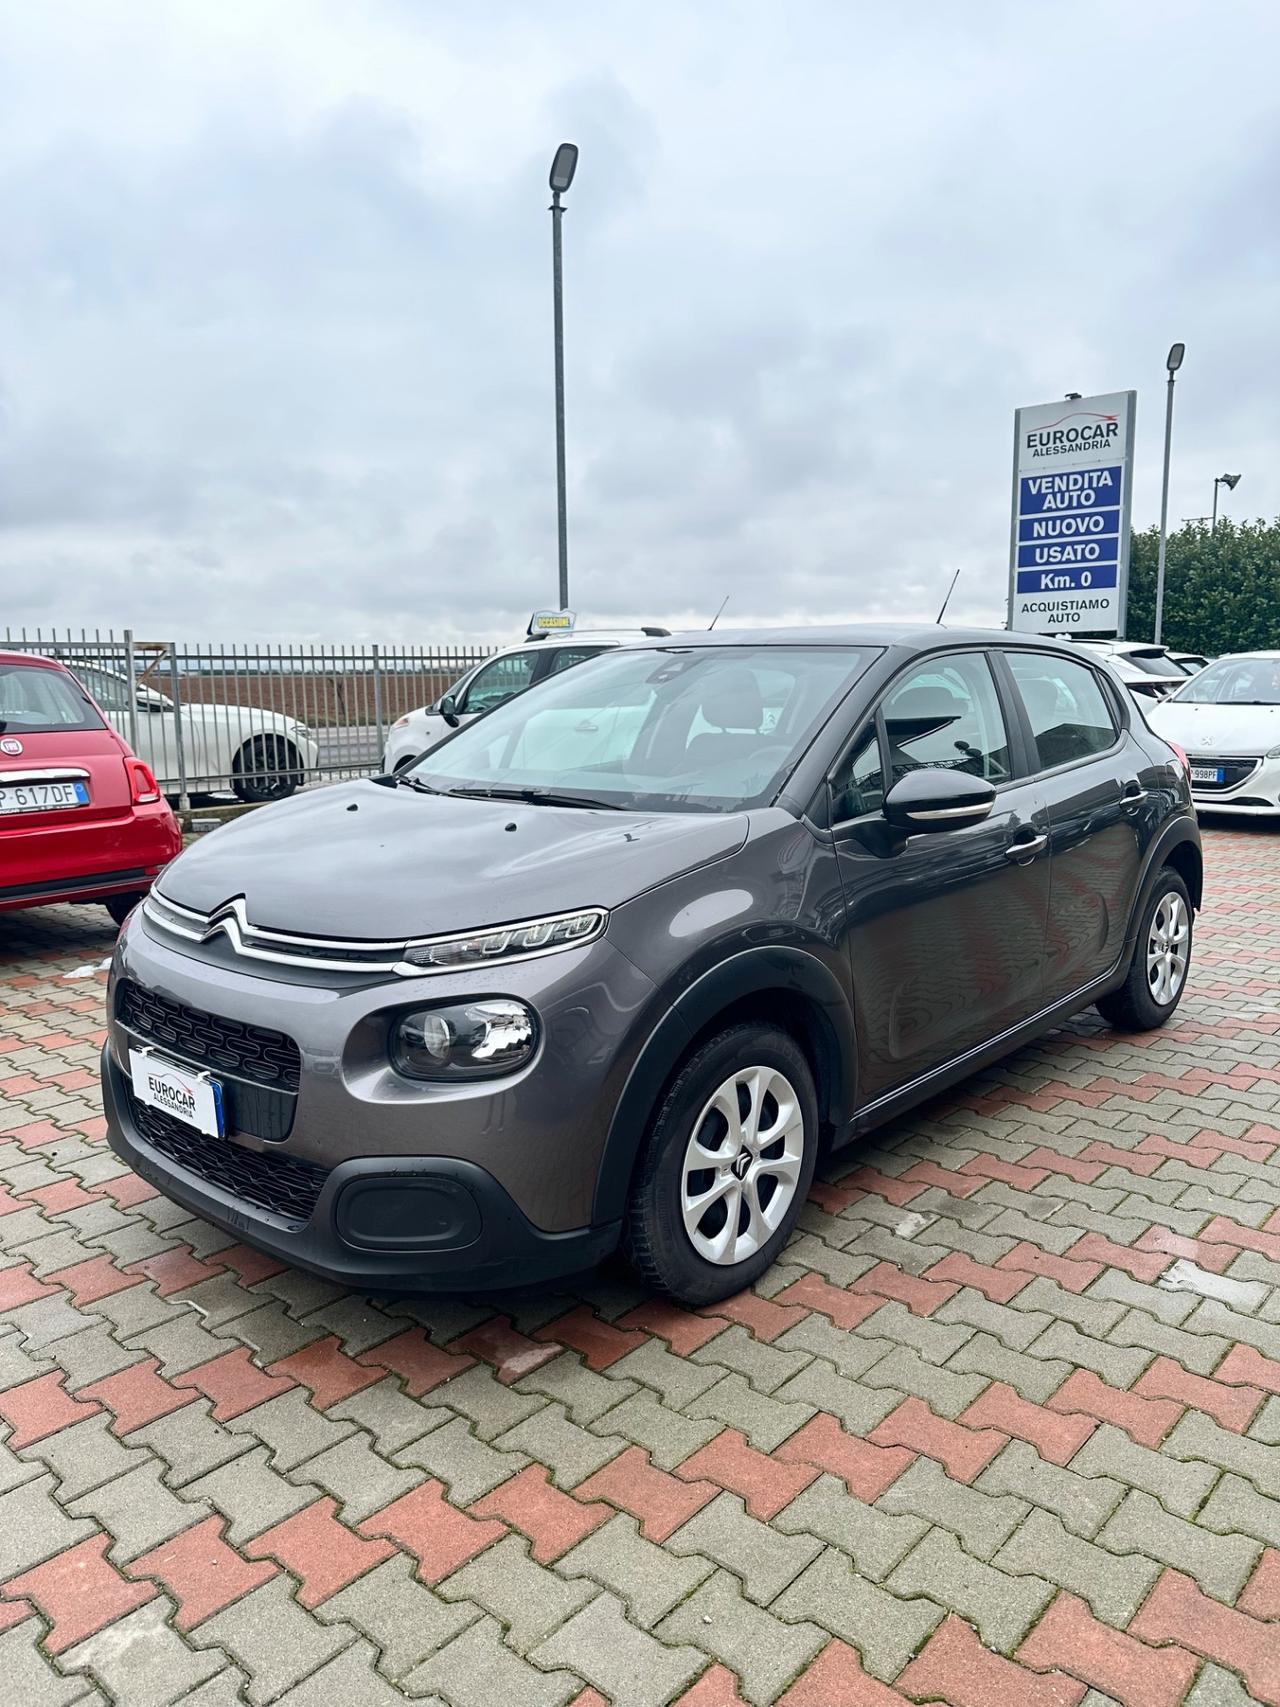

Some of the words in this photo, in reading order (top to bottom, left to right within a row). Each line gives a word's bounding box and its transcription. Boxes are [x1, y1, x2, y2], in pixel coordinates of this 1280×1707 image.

[1027, 423, 1118, 448] EUROCAR
[1032, 438, 1111, 458] ALESSANDRIA
[1028, 470, 1113, 495] VENDITA
[1042, 489, 1096, 510] AUTO
[1033, 516, 1104, 537] NUOVO
[1035, 543, 1099, 563] USATO
[1040, 574, 1075, 590] Km.
[1080, 571, 1092, 586] 0
[1021, 598, 1110, 614] ACQUISTIAMO
[1047, 612, 1081, 624] AUTO
[15, 786, 72, 805] 617DF
[148, 1076, 196, 1111] EUROCAR
[153, 1093, 193, 1119] ALESSANDRIA
